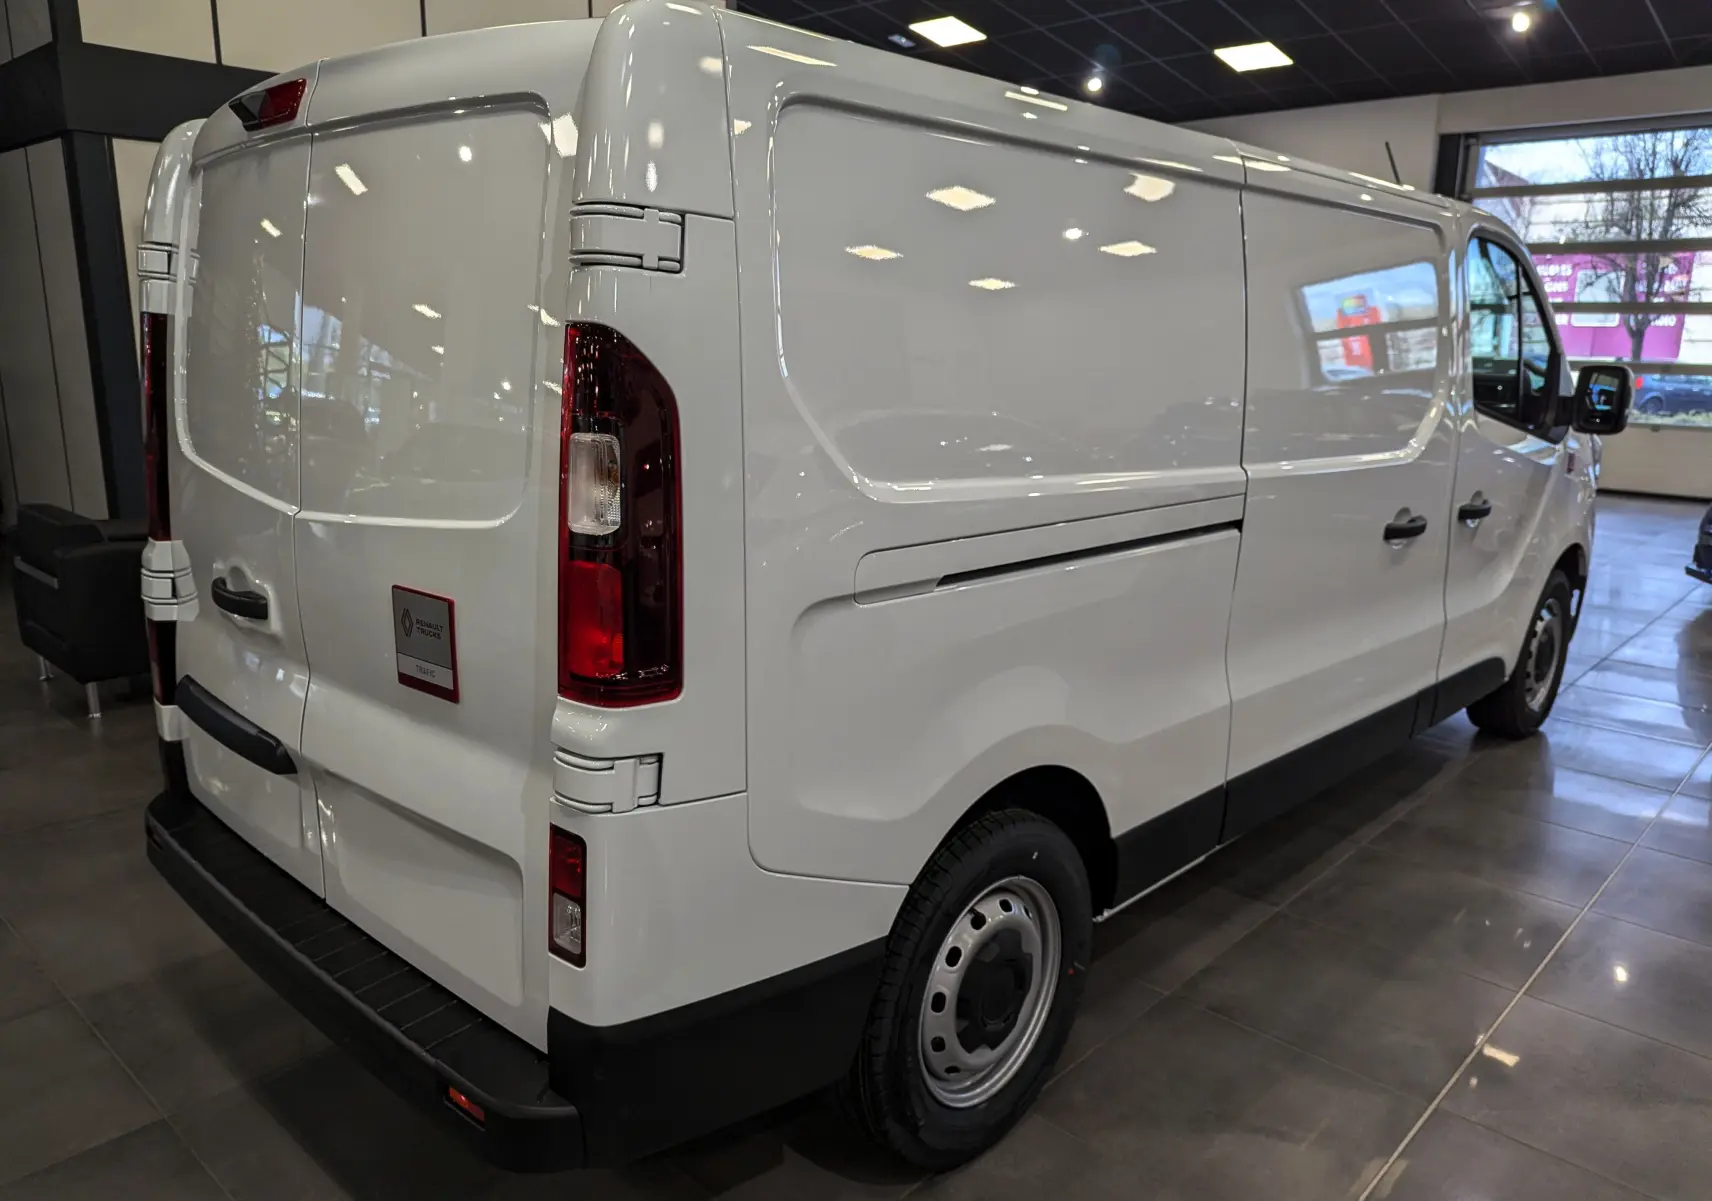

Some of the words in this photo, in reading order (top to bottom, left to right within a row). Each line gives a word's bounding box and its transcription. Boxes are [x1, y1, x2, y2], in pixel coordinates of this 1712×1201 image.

[416, 619, 444, 632] RENAULT
[416, 627, 442, 640] TRUCKS
[415, 665, 436, 678] TRAFIC
